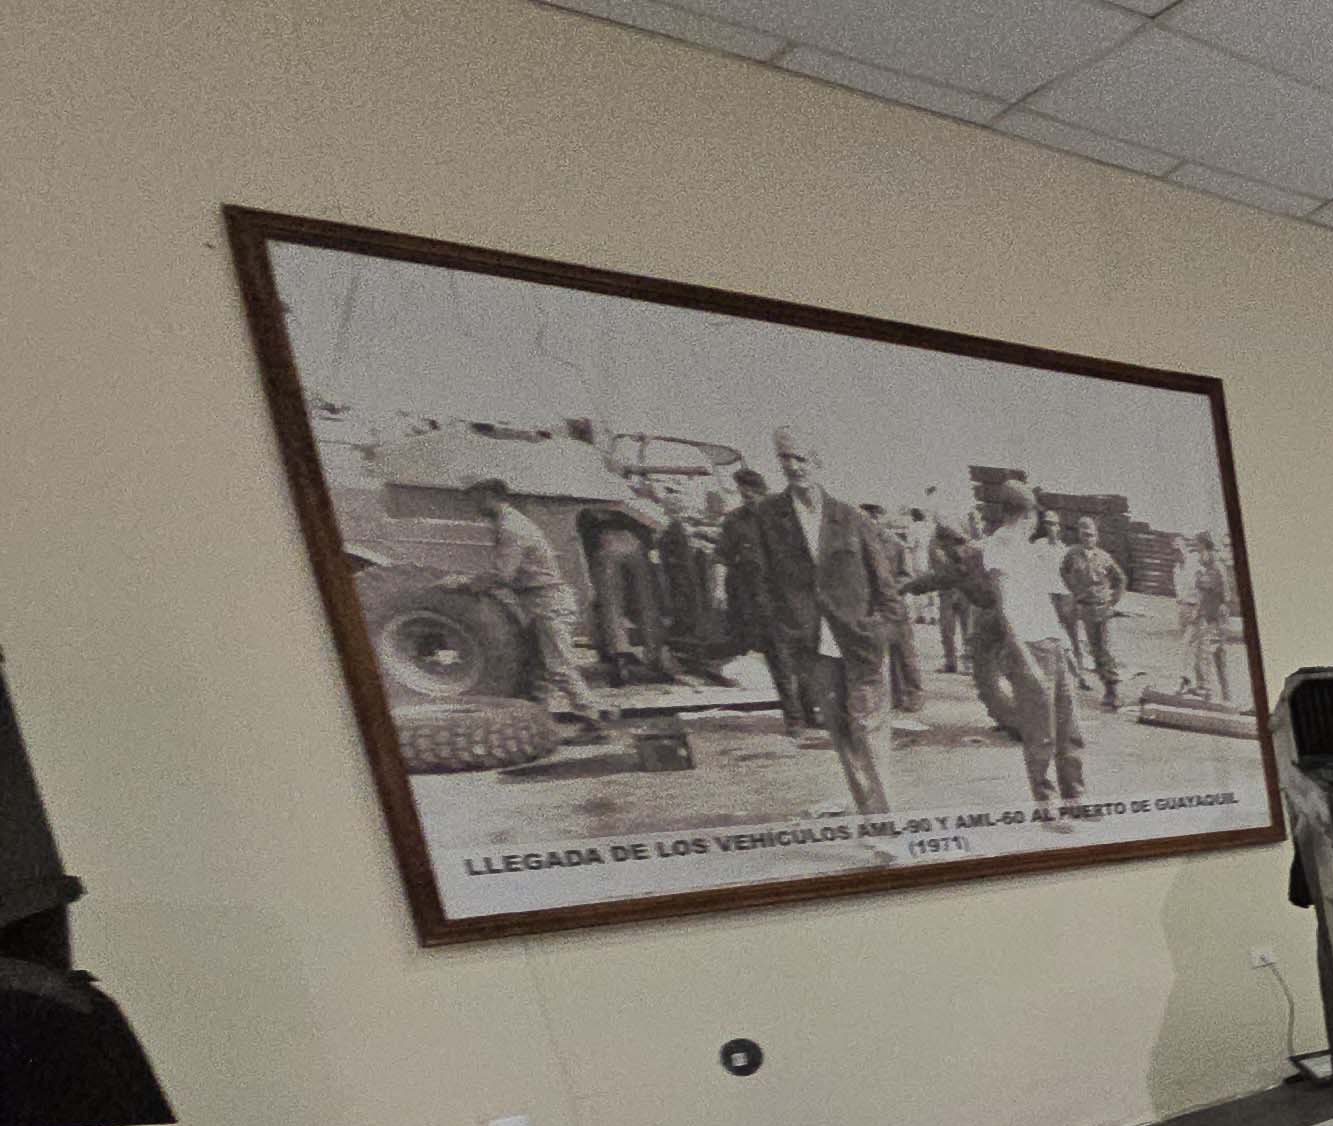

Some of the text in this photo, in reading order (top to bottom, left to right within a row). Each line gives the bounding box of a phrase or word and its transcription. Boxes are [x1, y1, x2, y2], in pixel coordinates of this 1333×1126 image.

[464, 848, 605, 876] LLEGADA
[610, 843, 650, 863] DE
[655, 838, 709, 859] LOS
[857, 815, 933, 838] AML-90
[936, 815, 949, 830] Y
[955, 809, 1027, 830] AML-60
[1031, 807, 1056, 823] AL
[1058, 800, 1127, 820] PUERTO
[1130, 798, 1152, 814] DE
[1154, 792, 1240, 812] GUAYAQUIL
[907, 834, 969, 857] (1971)
